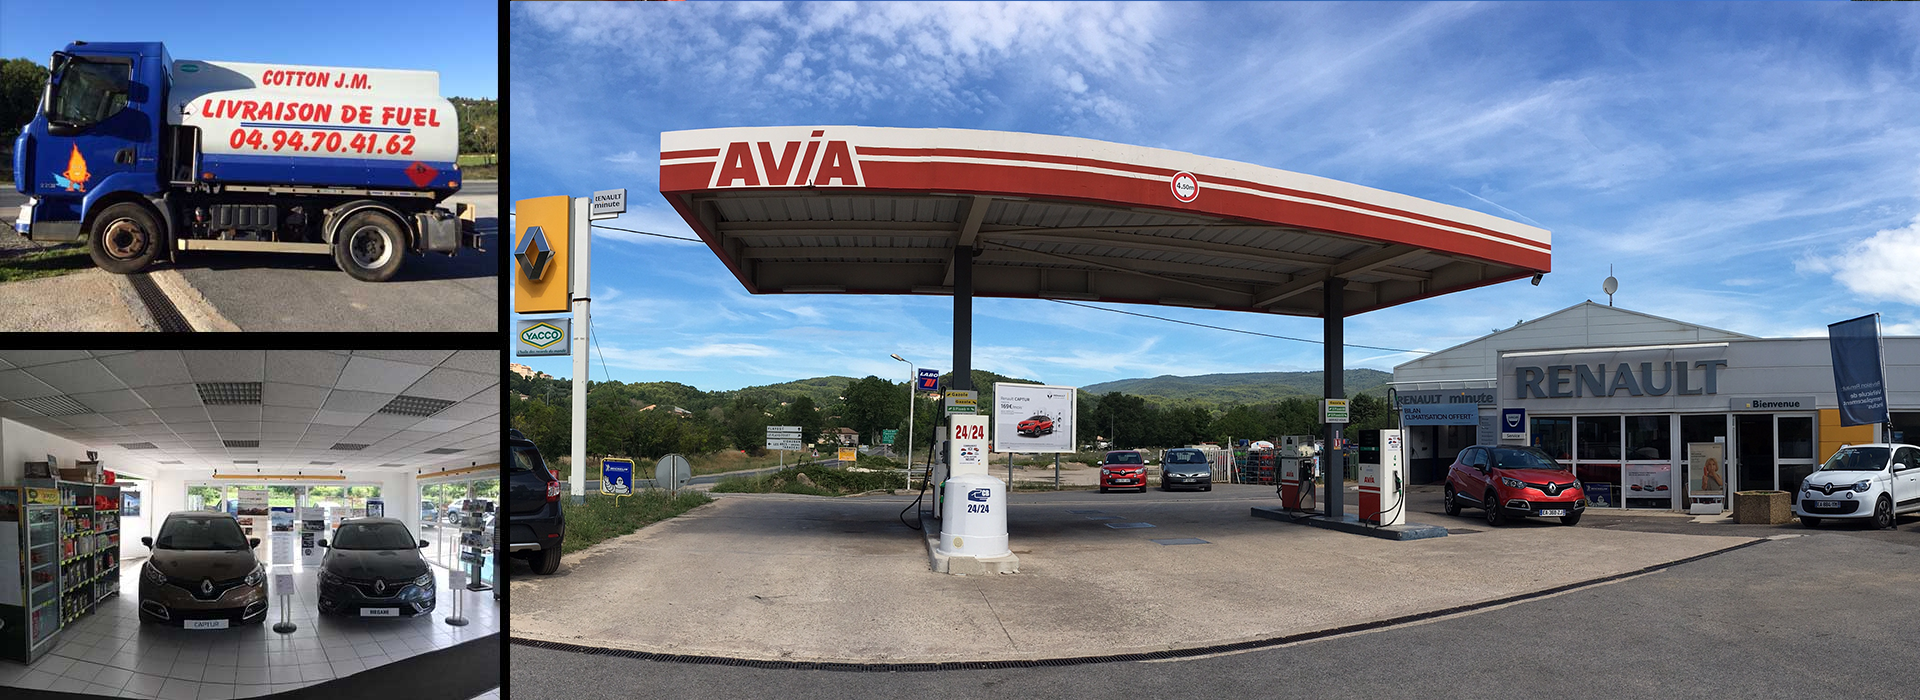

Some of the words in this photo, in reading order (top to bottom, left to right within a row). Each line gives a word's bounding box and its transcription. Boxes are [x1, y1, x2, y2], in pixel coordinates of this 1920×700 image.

[262, 69, 330, 88] COTTON
[334, 73, 372, 90] J.M.
[202, 99, 332, 122] LIVRAISON
[341, 104, 373, 124] DE
[382, 106, 441, 127] FUEL
[229, 128, 416, 155] 04.94.70.41.62
[594, 200, 620, 209] minute
[526, 331, 559, 340] YACCO
[1515, 359, 1728, 399] RENAULT
[1397, 394, 1442, 404] RENAULT
[1449, 392, 1494, 404] minute
[1752, 400, 1800, 408] Bienvenue
[955, 424, 984, 439] 24/24
[967, 504, 990, 514] 24/24
